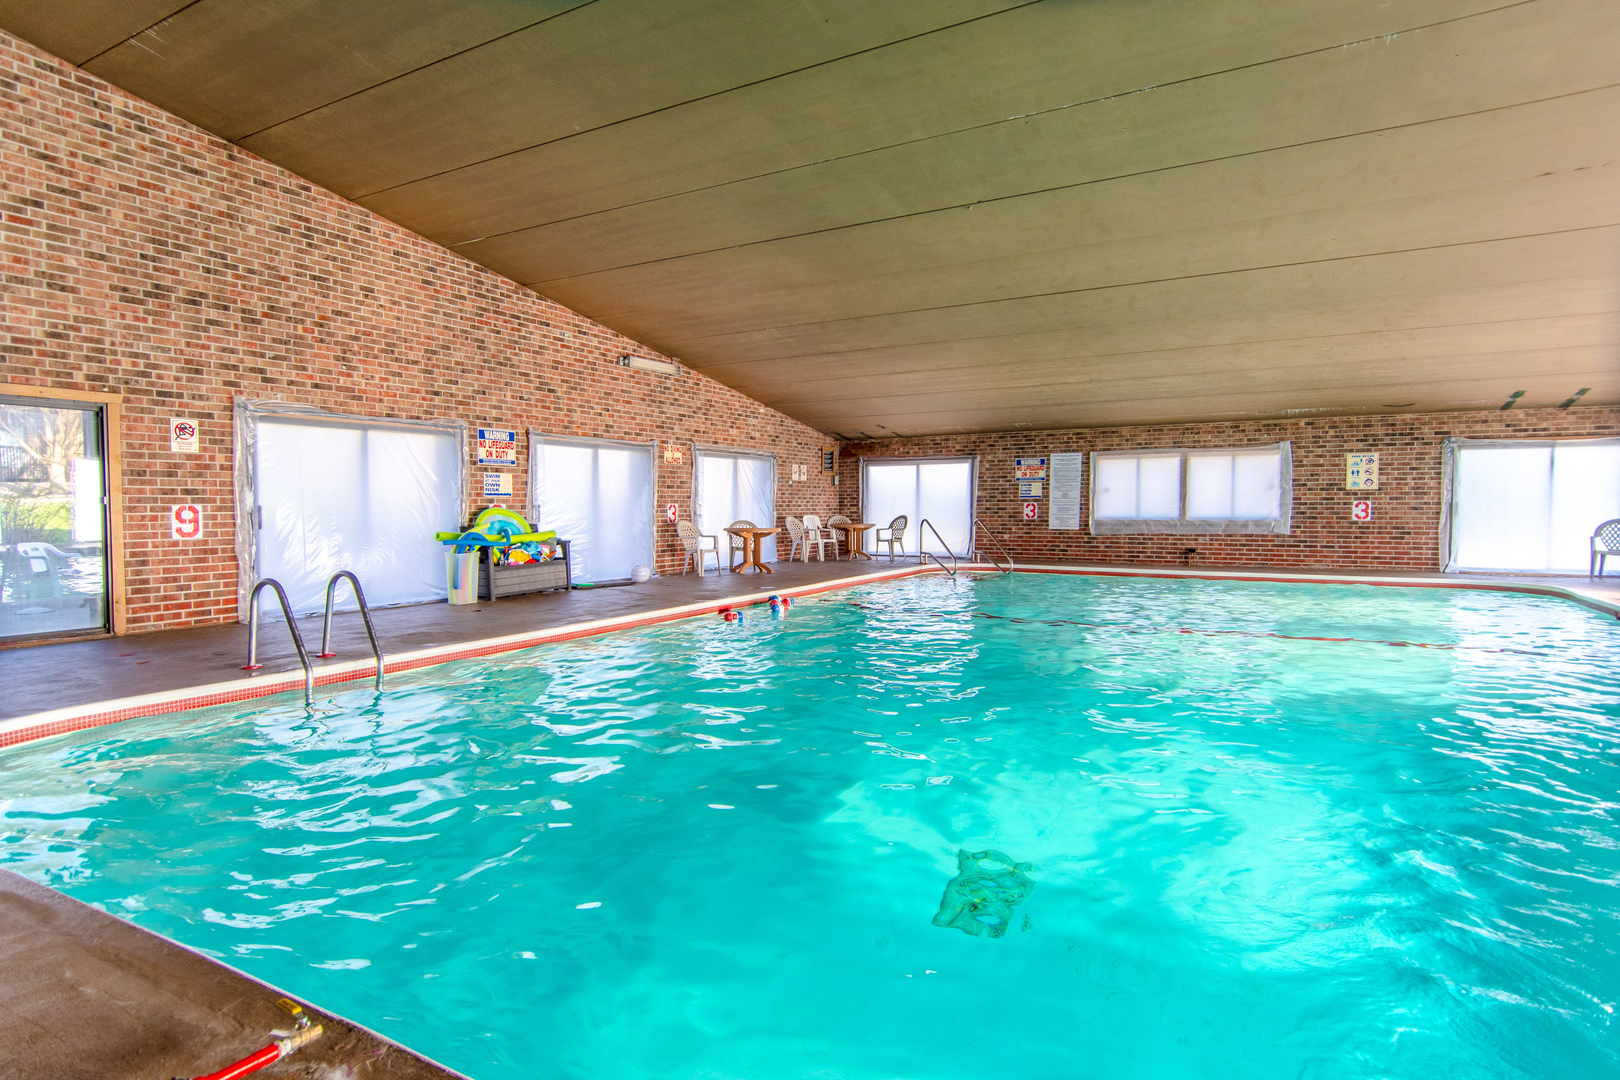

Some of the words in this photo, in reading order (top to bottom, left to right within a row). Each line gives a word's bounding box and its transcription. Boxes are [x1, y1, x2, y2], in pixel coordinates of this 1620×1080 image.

[484, 430, 510, 440] WARNING
[479, 440, 487, 448] NO
[488, 440, 514, 450] LIFEGUARD
[485, 449, 494, 458] ON
[495, 450, 509, 458] DUTY
[668, 504, 677, 523] 3
[1026, 503, 1036, 518] 3
[1355, 501, 1369, 520] 3
[175, 505, 199, 537] 9
